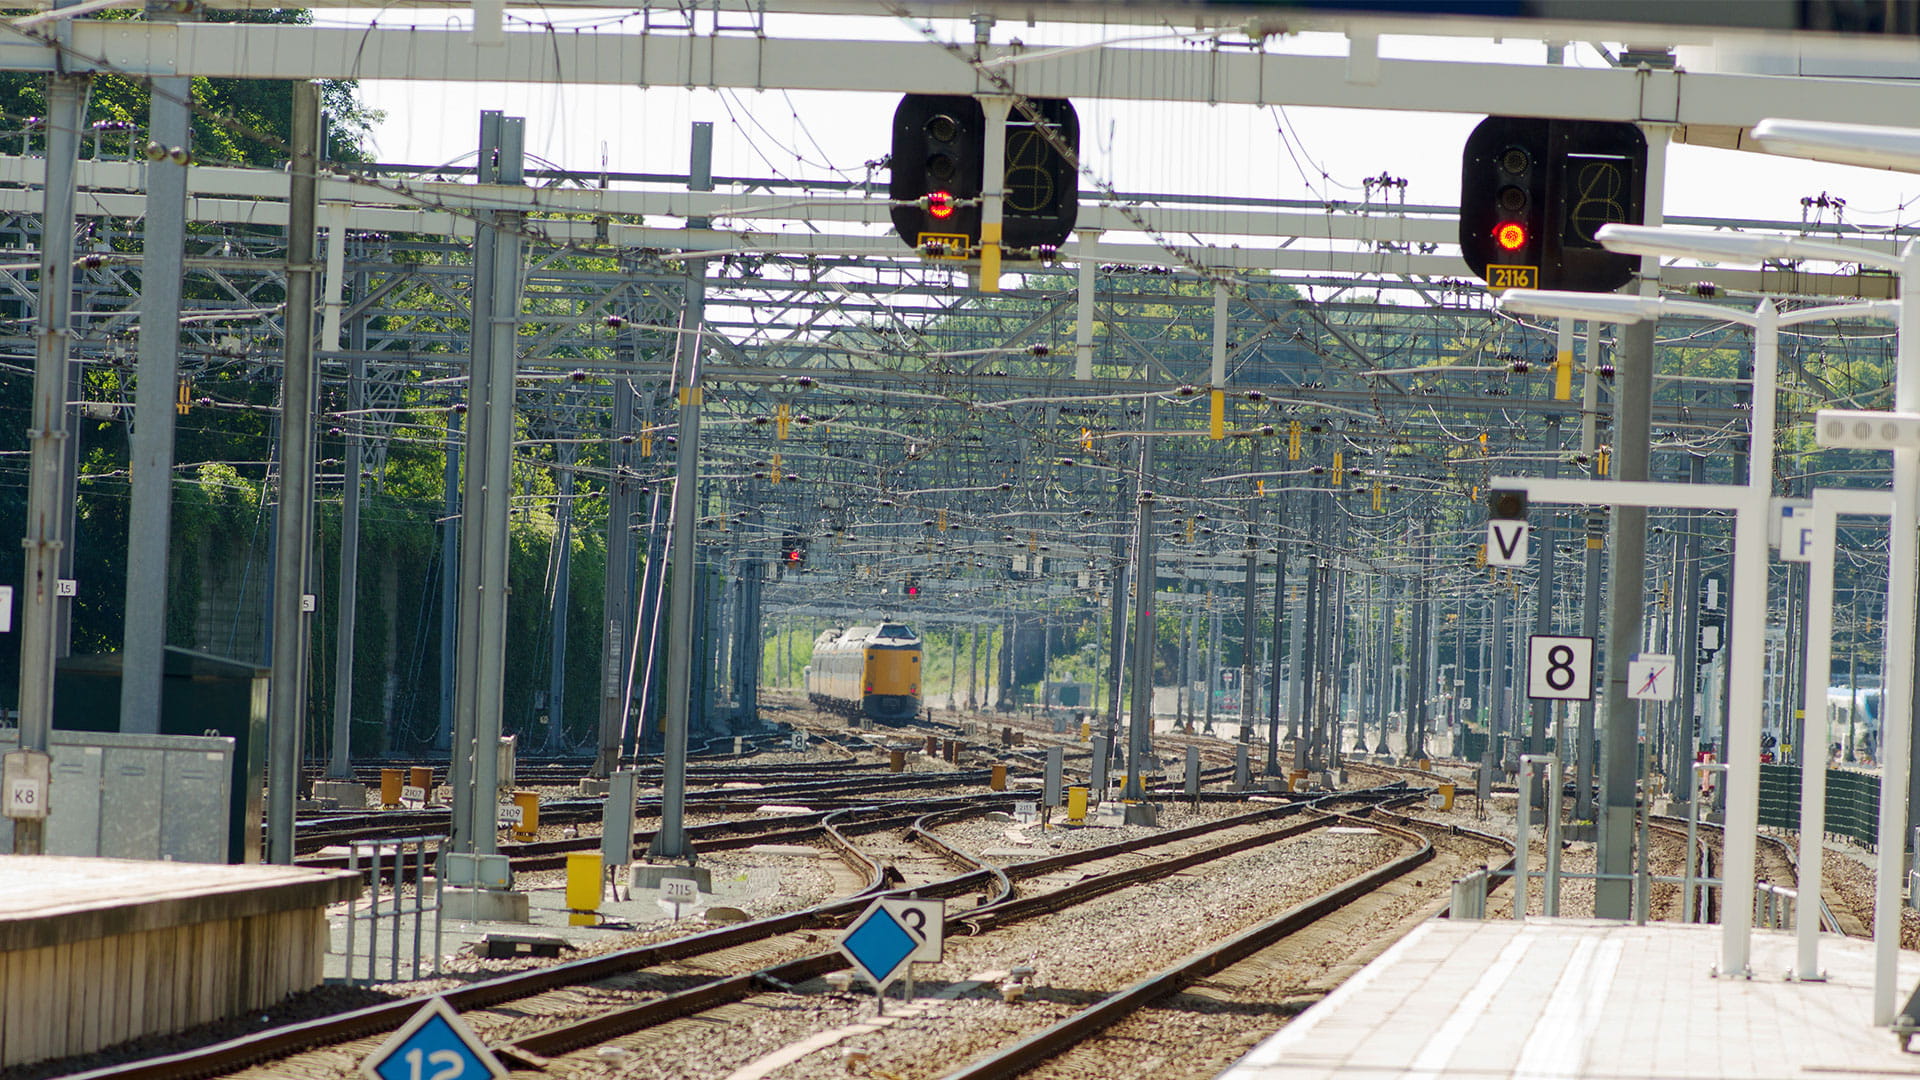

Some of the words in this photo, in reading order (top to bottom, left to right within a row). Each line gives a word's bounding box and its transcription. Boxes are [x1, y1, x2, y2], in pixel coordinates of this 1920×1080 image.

[1495, 269, 1529, 287] 2116
[1493, 526, 1524, 560] V
[1546, 645, 1575, 691] 8
[795, 735, 803, 748] 8
[15, 788, 34, 804] K8
[500, 808, 521, 818] 2109
[667, 882, 692, 897] 2115
[405, 1048, 465, 1080] 12
